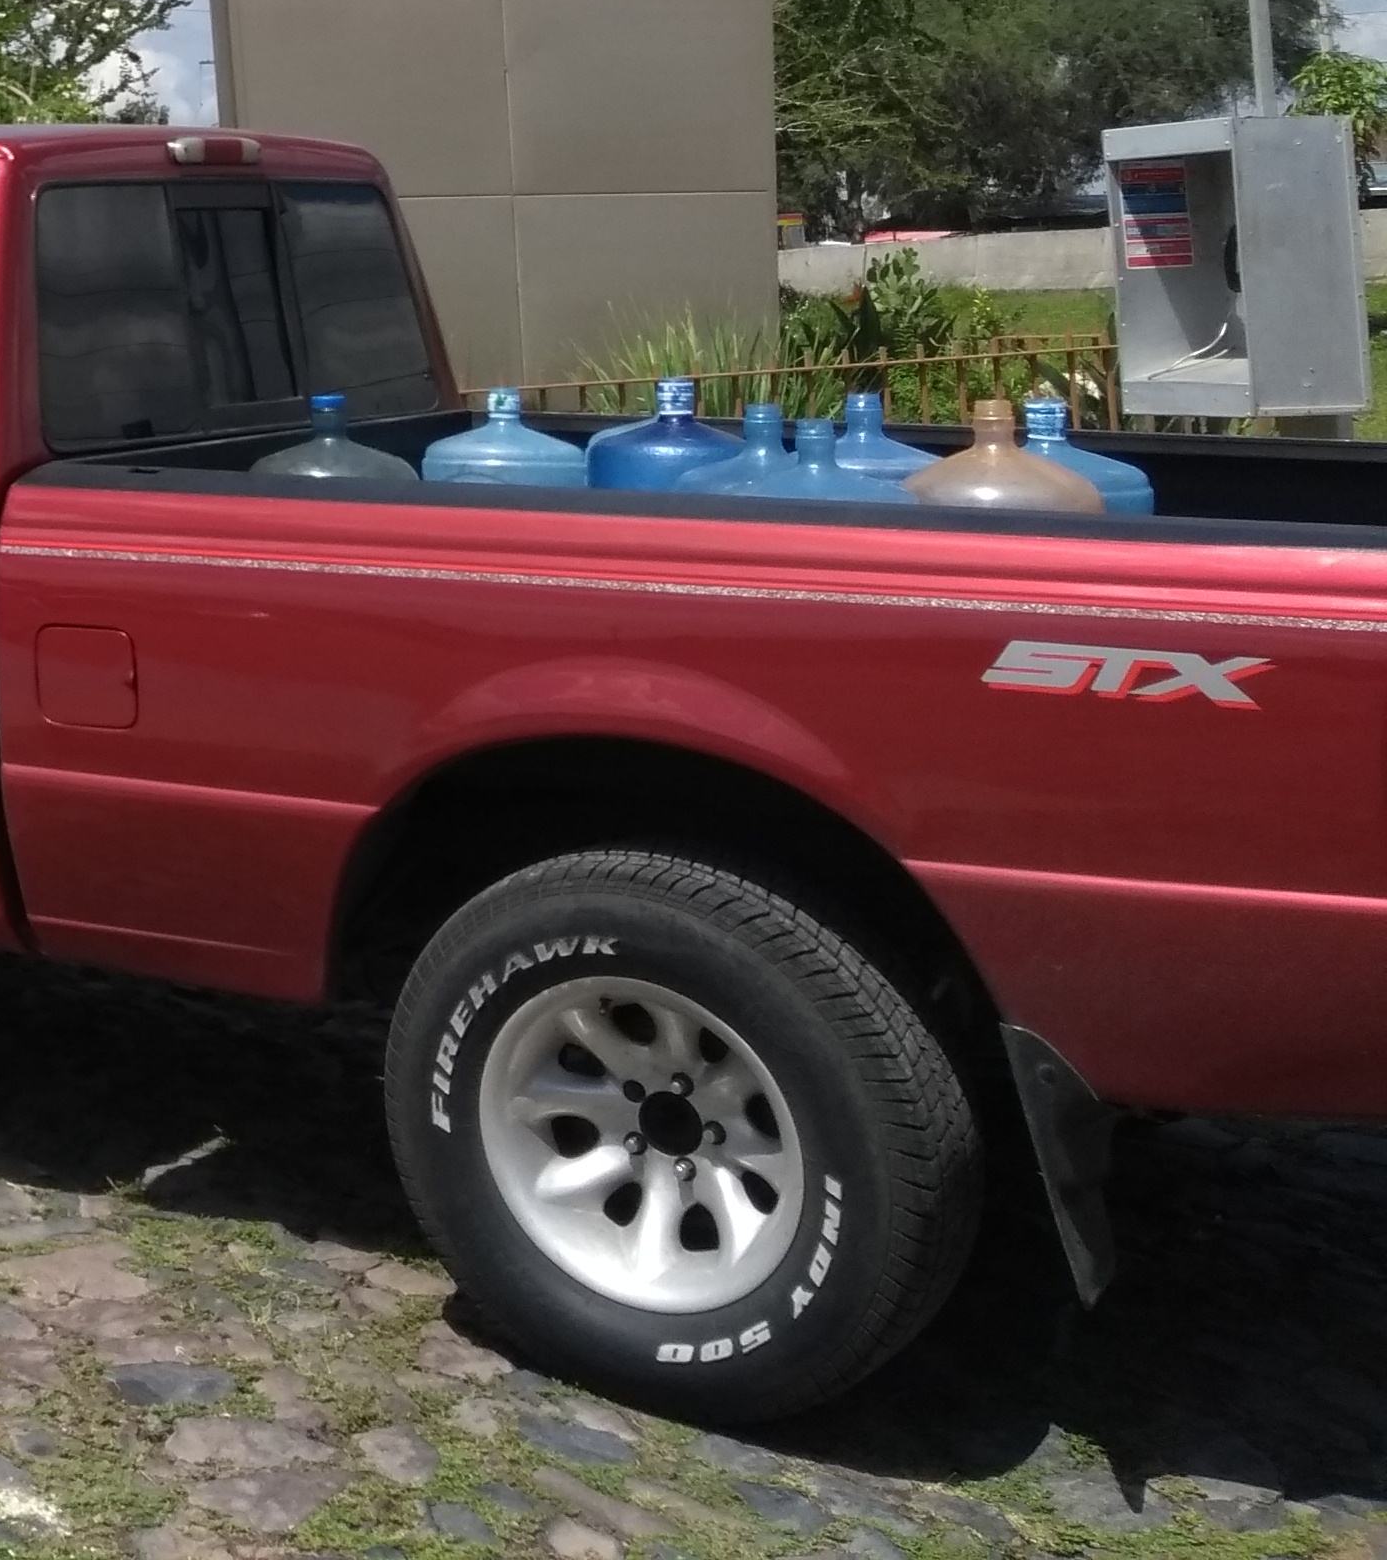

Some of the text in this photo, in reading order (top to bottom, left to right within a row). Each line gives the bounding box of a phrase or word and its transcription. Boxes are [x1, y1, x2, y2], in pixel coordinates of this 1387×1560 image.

[980, 640, 1278, 710] STX
[431, 935, 620, 1134] FIREHAWK
[656, 1173, 844, 1364] INDY 500
